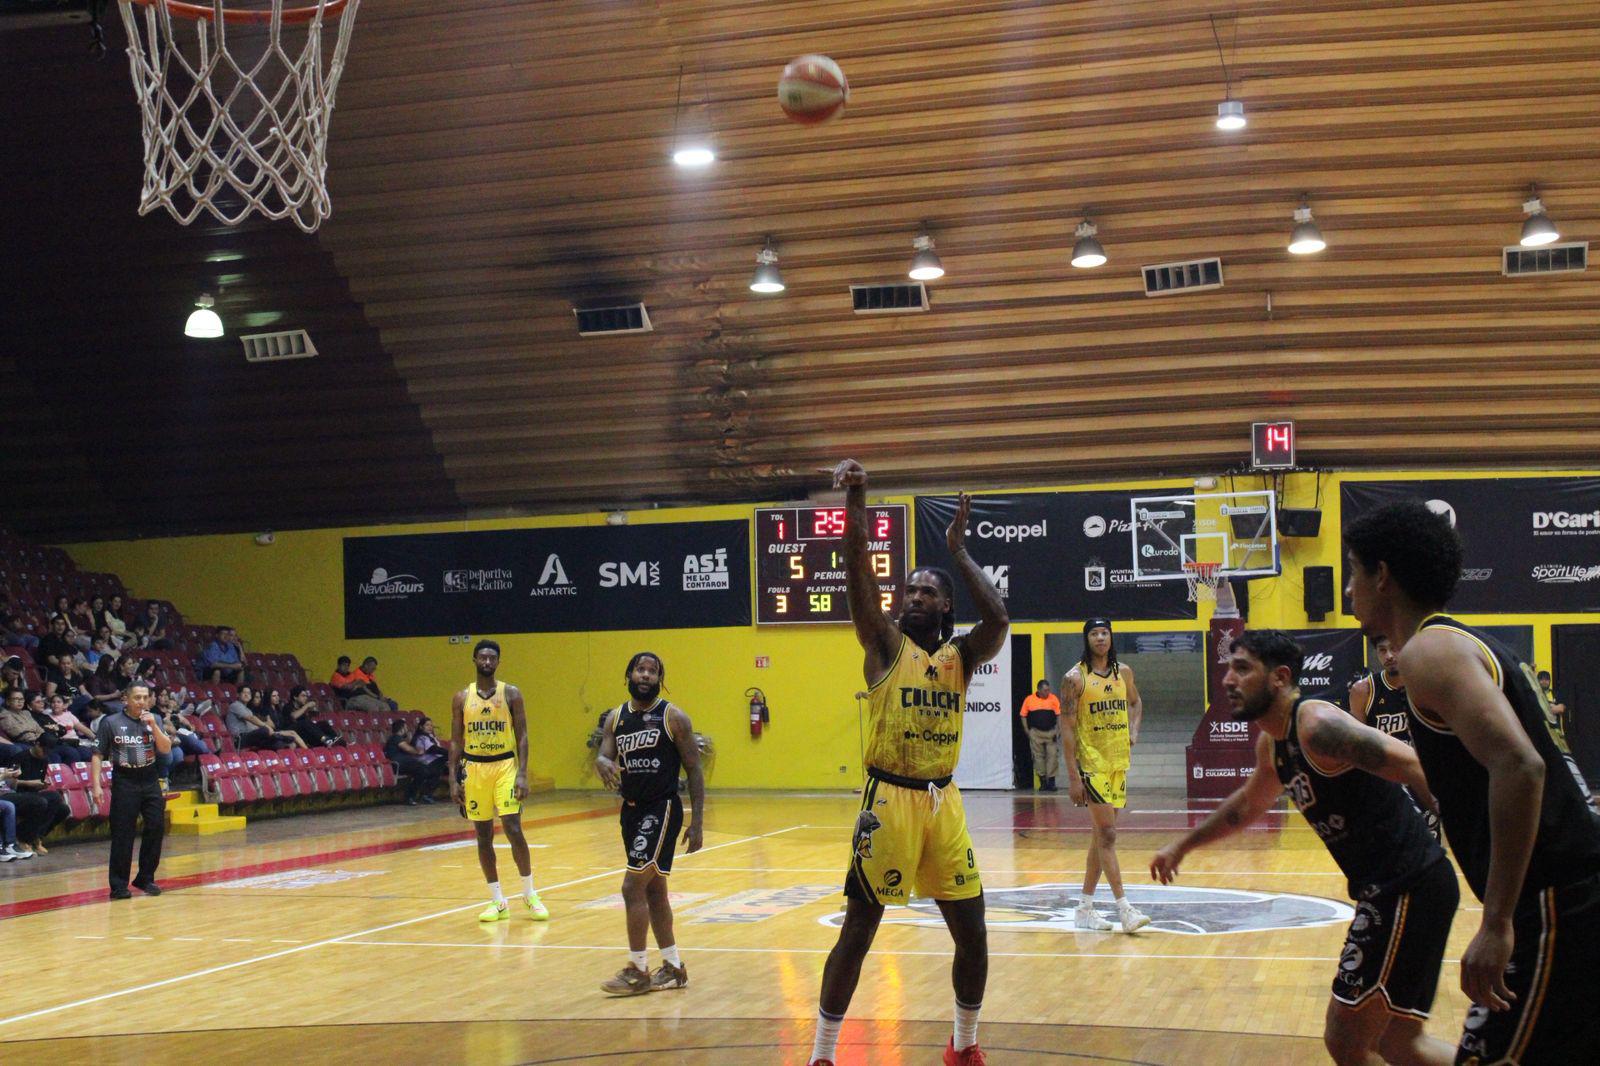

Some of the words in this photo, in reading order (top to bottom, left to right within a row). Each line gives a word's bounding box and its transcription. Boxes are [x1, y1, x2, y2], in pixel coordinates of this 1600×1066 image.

[1267, 426, 1289, 452] 14
[814, 511, 846, 535] 2:5
[877, 519, 889, 538] 2
[1532, 510, 1600, 529] D'Gari
[777, 522, 784, 540] 1
[976, 519, 1047, 543] Coppel
[768, 543, 807, 553] GUEST
[866, 541, 892, 551] OME
[683, 547, 728, 574] ASÍ
[789, 556, 804, 579] 5
[831, 551, 837, 569] 1
[871, 553, 890, 577] 13
[598, 561, 647, 588] SM
[649, 560, 660, 586] MX
[686, 574, 698, 582] ME
[1109, 575, 1136, 583] CULI
[358, 580, 425, 595] NavolaTours
[530, 586, 577, 596] ANTARTIC
[686, 580, 727, 589] CONTARON
[806, 585, 847, 593] PLAYER-FO
[878, 584, 896, 592] ULS
[776, 595, 787, 613] 3
[809, 594, 831, 612] 58
[880, 593, 893, 611] 2
[918, 709, 949, 718] TOWN
[1220, 721, 1249, 733] ISDE
[1376, 712, 1407, 735] RAY
[616, 729, 661, 753] RAYOS
[922, 728, 959, 745] Coppel
[966, 847, 975, 869] 9
[875, 886, 904, 898] MEGA
